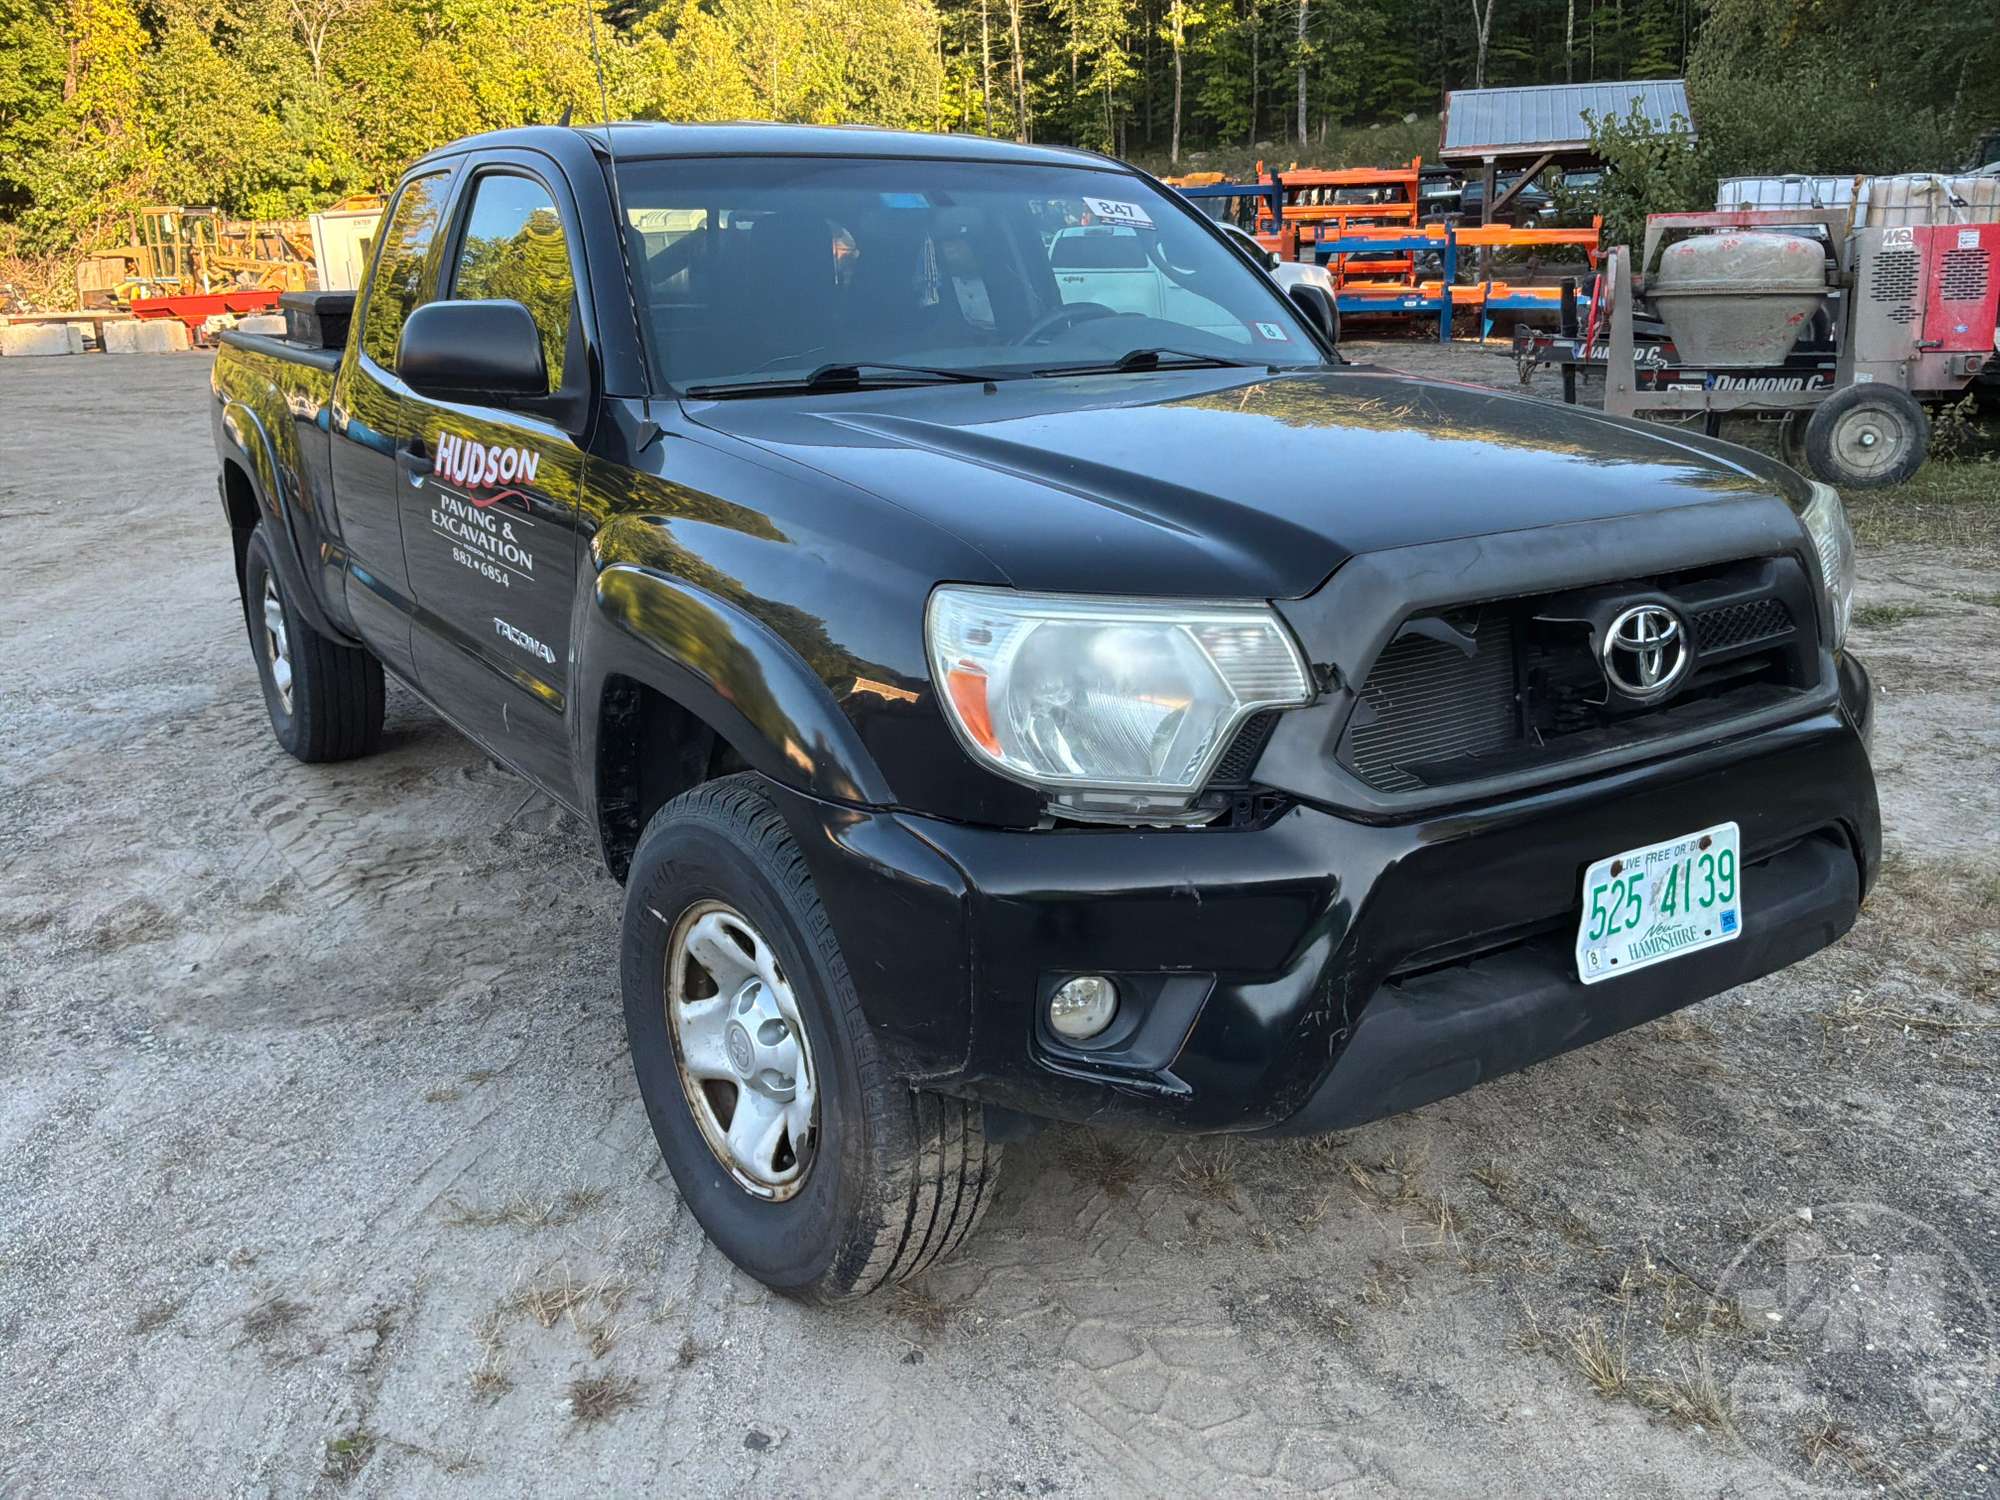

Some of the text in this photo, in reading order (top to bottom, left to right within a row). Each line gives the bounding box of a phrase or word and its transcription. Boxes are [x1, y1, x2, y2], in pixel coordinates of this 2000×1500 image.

[1098, 202, 1134, 217] 847
[1263, 324, 1277, 337] 8
[1713, 375, 1803, 392] DIAMOND
[434, 431, 540, 487] HUDSON
[441, 494, 519, 544] PAVING &
[431, 508, 533, 571] EXCAVATION
[493, 617, 557, 664] TACOMA
[1645, 848, 1671, 865] FREE
[1674, 843, 1687, 857] OR
[1589, 849, 1736, 941] 525 4139
[1628, 925, 1699, 960] HAMPSHIRE
[1641, 922, 1682, 941] New
[1590, 952, 1598, 965] 8
